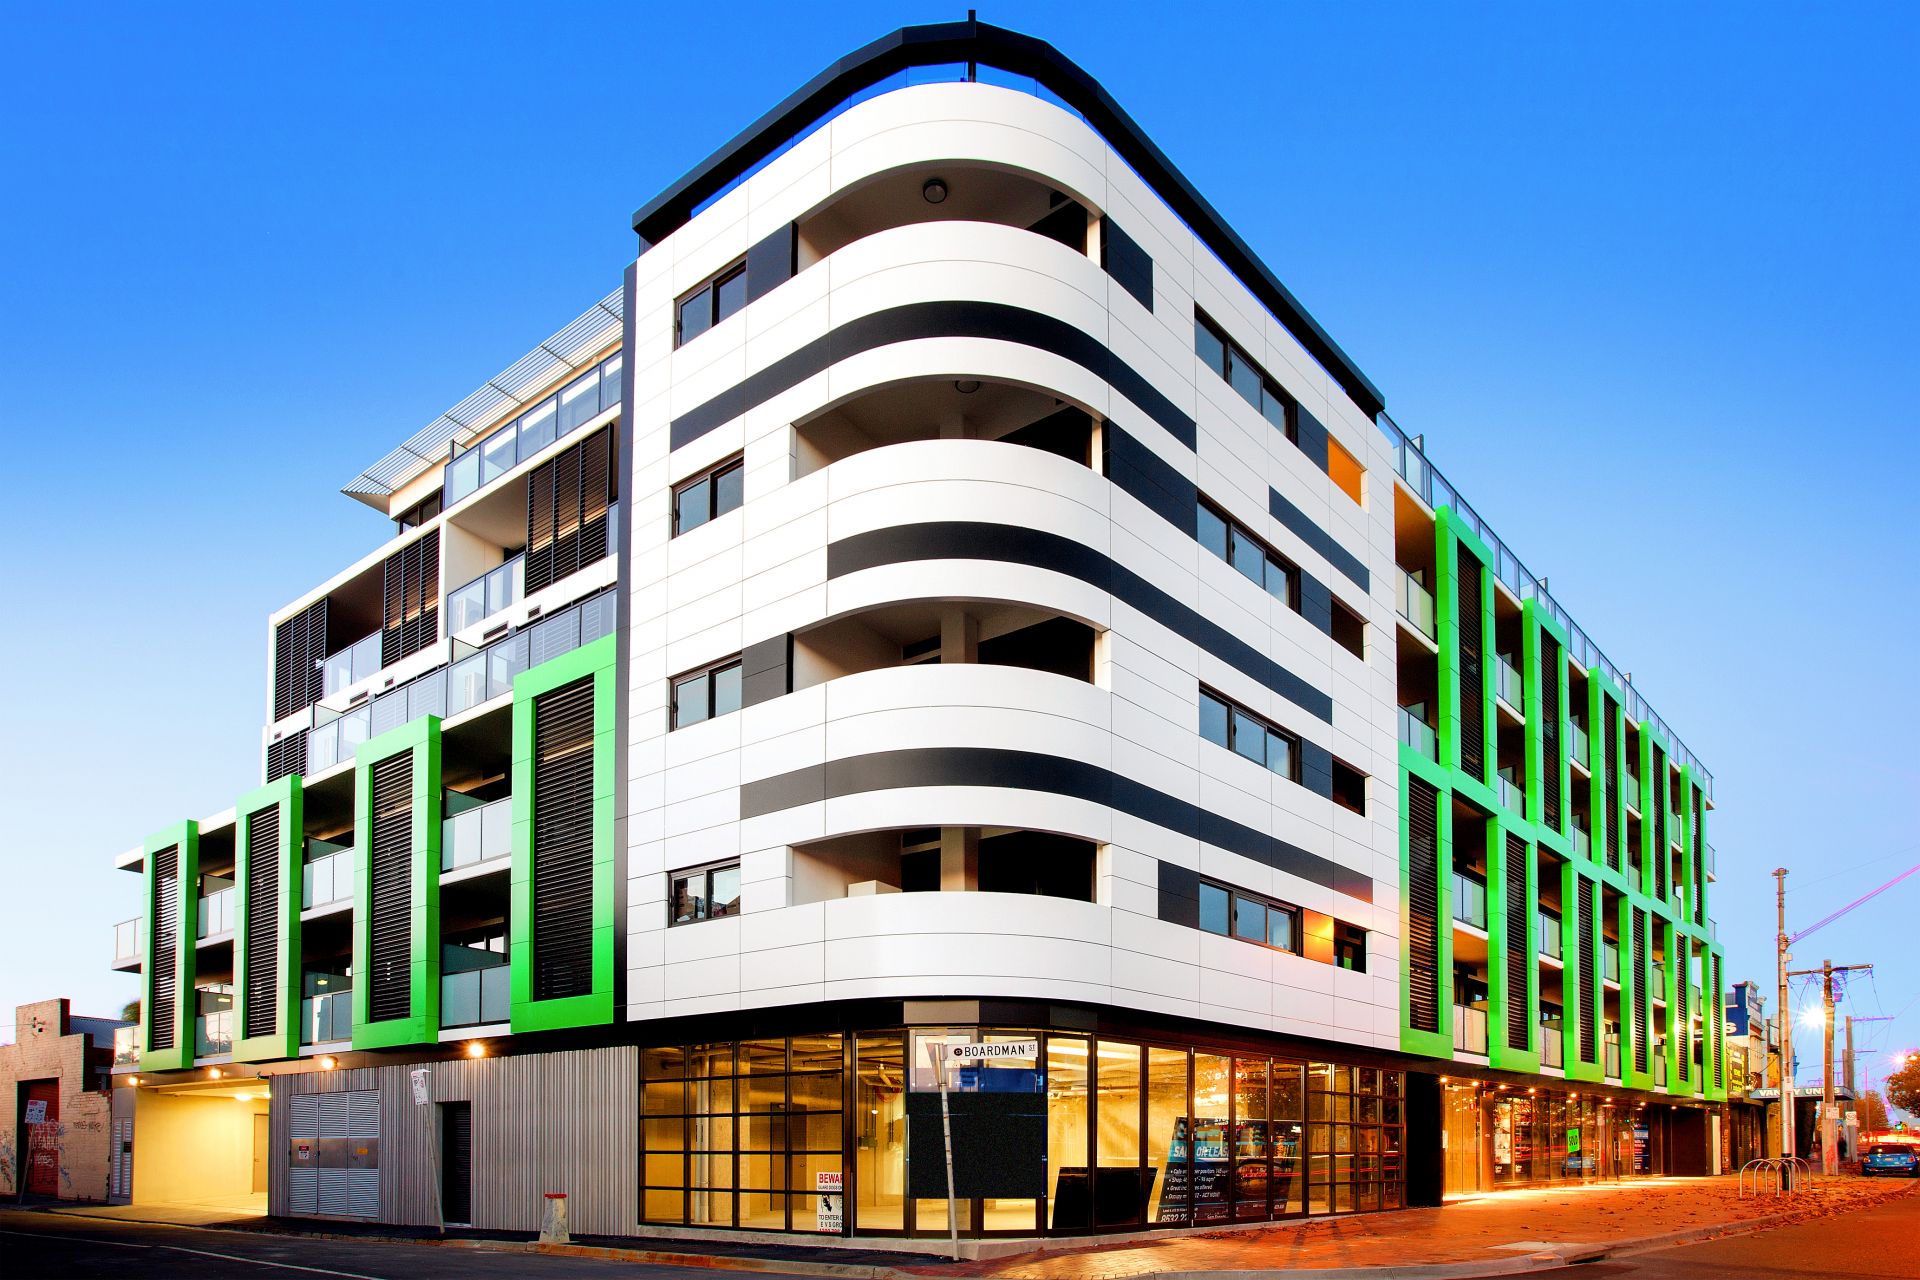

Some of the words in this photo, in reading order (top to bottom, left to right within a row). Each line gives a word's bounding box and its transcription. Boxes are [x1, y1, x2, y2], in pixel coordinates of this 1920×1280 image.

[964, 1045, 1025, 1056] BOARDMAN
[1759, 1088, 1800, 1096] VANY
[1208, 1146, 1229, 1157] LEAS
